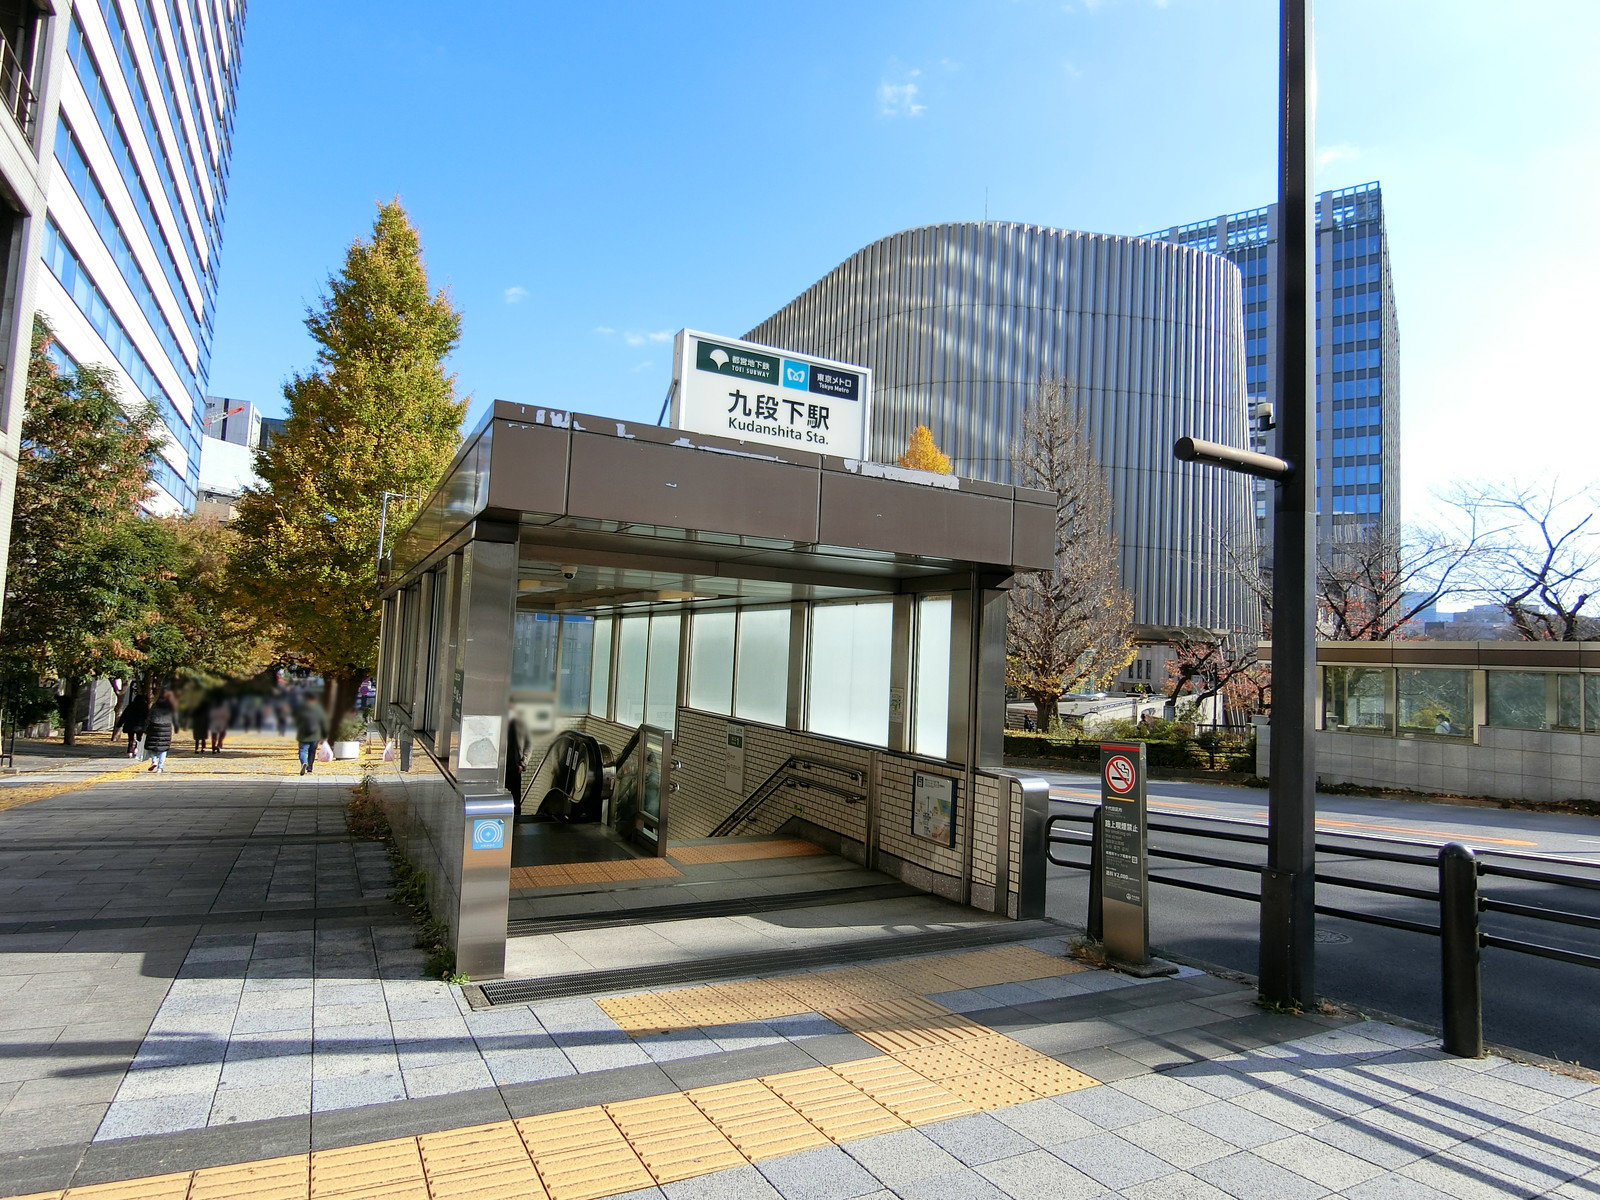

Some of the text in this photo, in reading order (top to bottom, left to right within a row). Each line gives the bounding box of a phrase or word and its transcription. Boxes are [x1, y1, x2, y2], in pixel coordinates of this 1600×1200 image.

[732, 355, 770, 371] 都営地下鉄
[732, 365, 770, 378] TOEI SUBWAY
[817, 373, 852, 388] 東京メトロ
[819, 382, 849, 394] Tokyo Metro
[728, 389, 830, 431] 九段下駅
[728, 417, 829, 445] Kudanshita Sta.
[1104, 819, 1139, 833] 路上喫煙禁止
